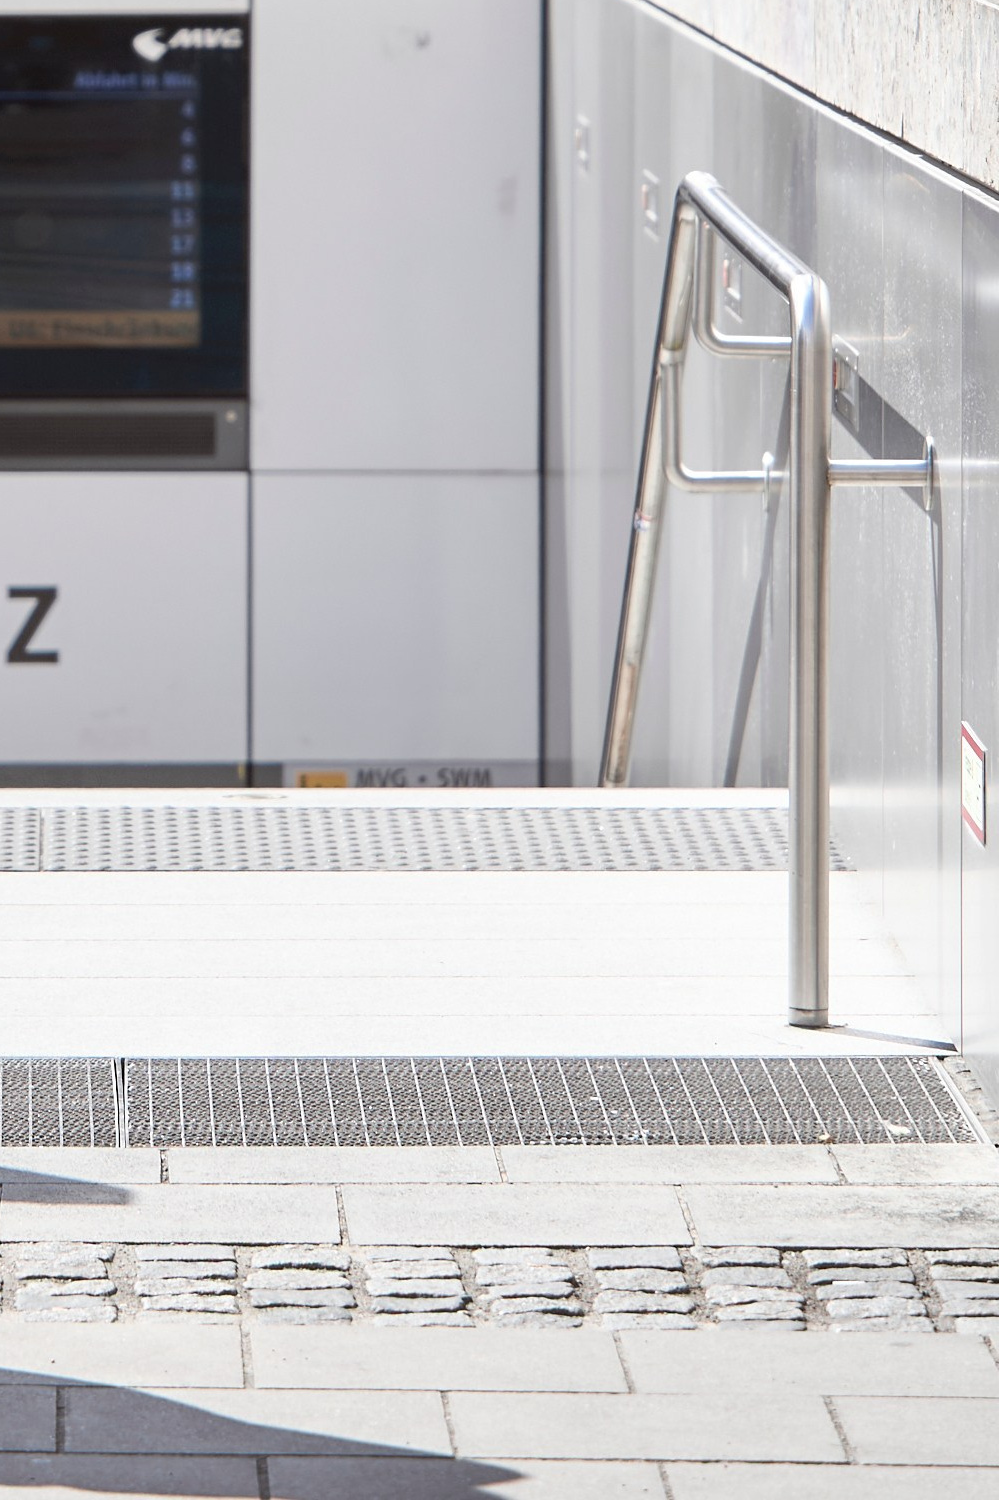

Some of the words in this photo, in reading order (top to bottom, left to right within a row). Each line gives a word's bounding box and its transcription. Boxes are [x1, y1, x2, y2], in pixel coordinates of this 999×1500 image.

[168, 28, 243, 49] MVG
[357, 767, 406, 787] MVG
[437, 767, 493, 787] SWM
